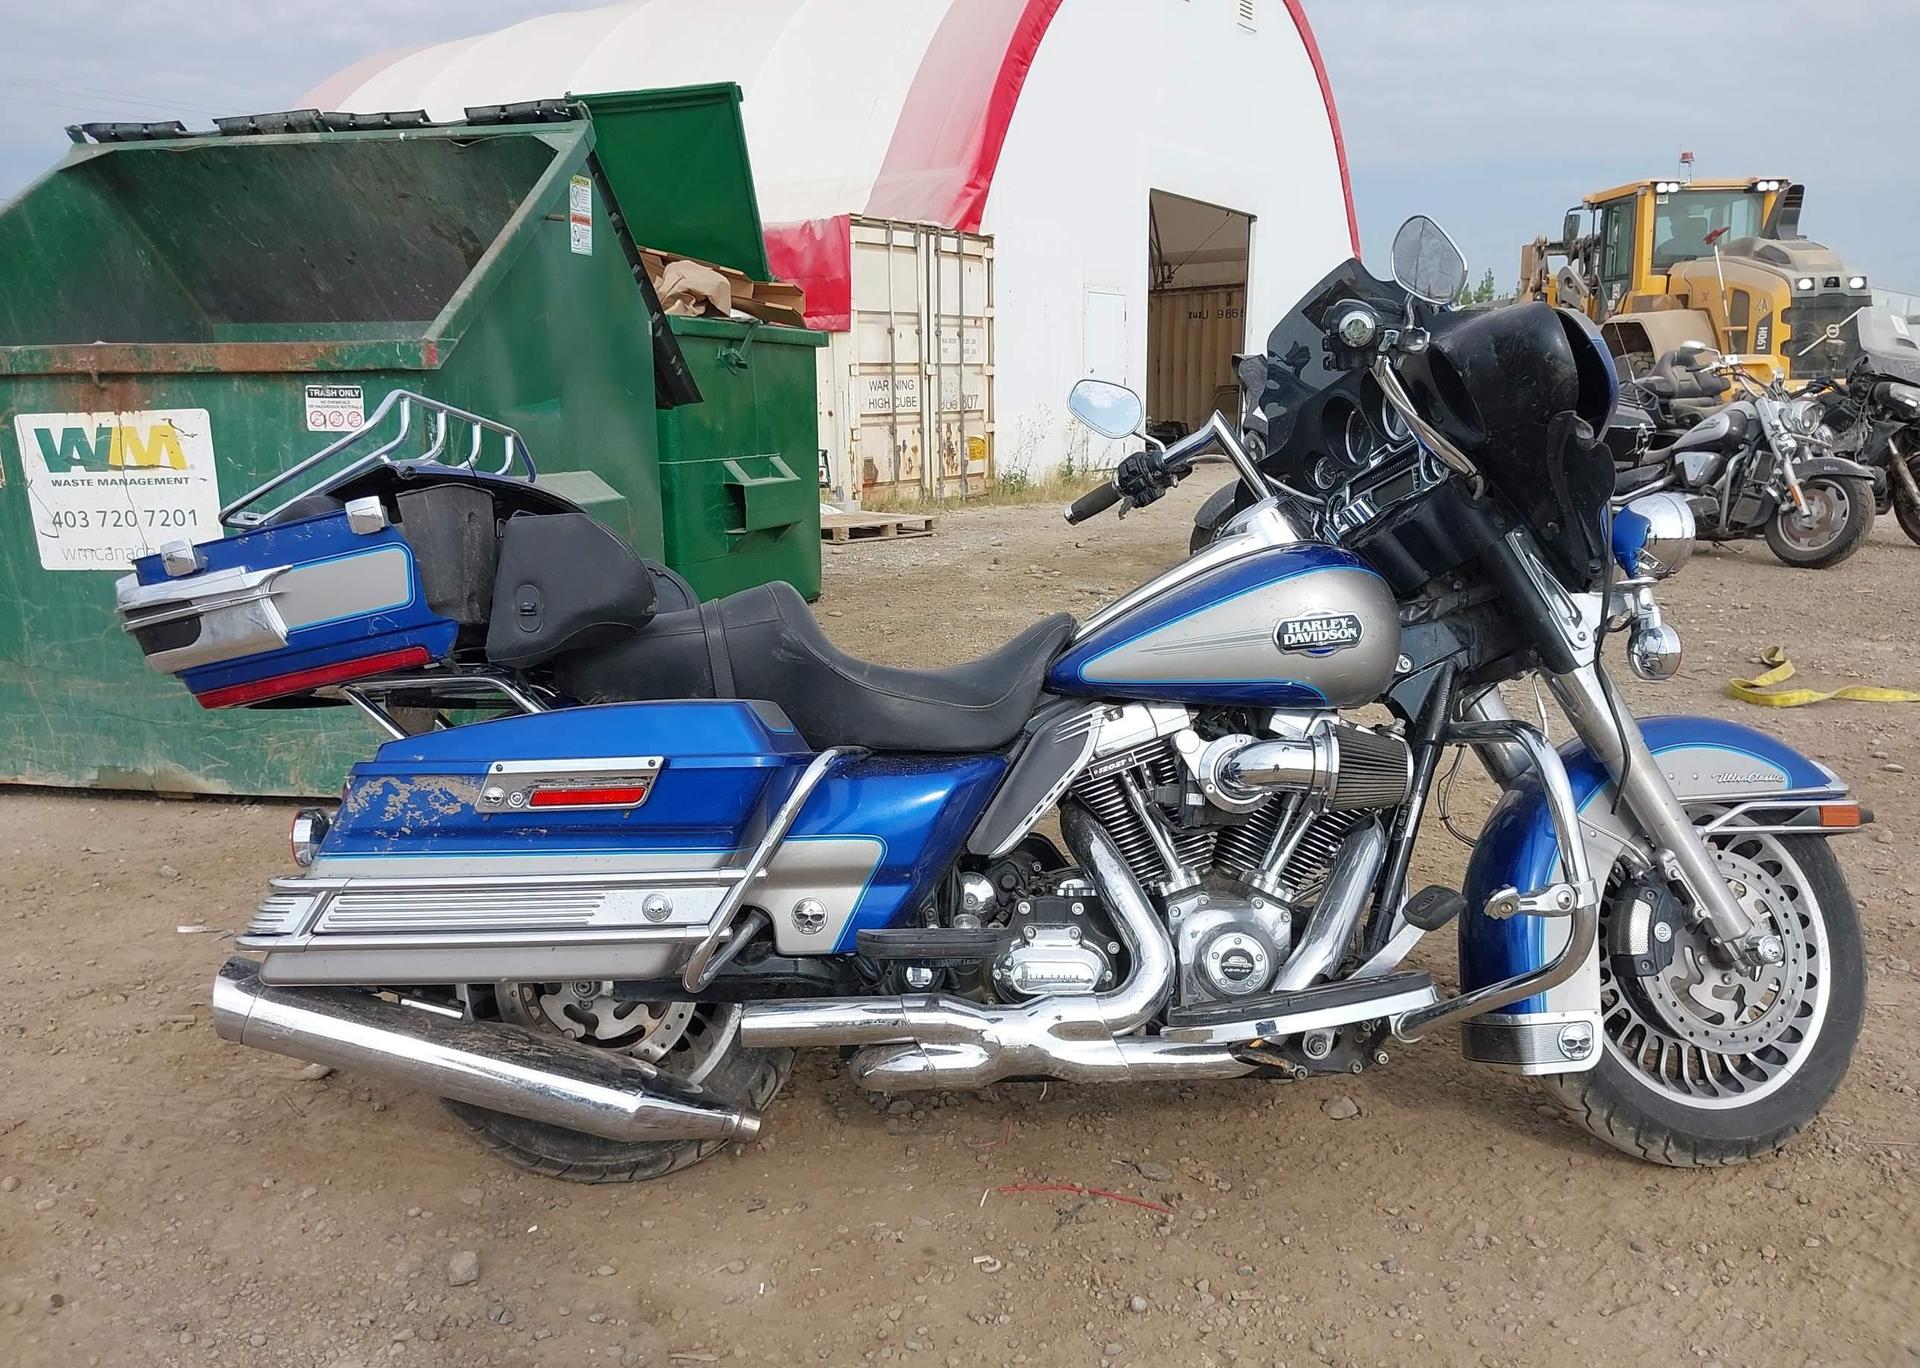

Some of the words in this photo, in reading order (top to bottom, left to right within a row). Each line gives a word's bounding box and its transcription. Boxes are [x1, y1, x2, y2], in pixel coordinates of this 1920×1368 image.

[1756, 326, 1768, 350] L90H
[309, 389, 337, 398] TRASH
[338, 389, 360, 398] ONLY
[868, 397, 891, 410] HIGH
[894, 396, 917, 409] CUBE
[34, 425, 188, 473] WM
[51, 478, 94, 487] WASTE
[97, 476, 191, 487] MANAGEMENT
[52, 510, 90, 528] 403
[96, 510, 137, 528] 720
[144, 509, 198, 527] 7201
[1287, 617, 1354, 634] HARLEY-
[1283, 627, 1358, 645] DAVIDSON
